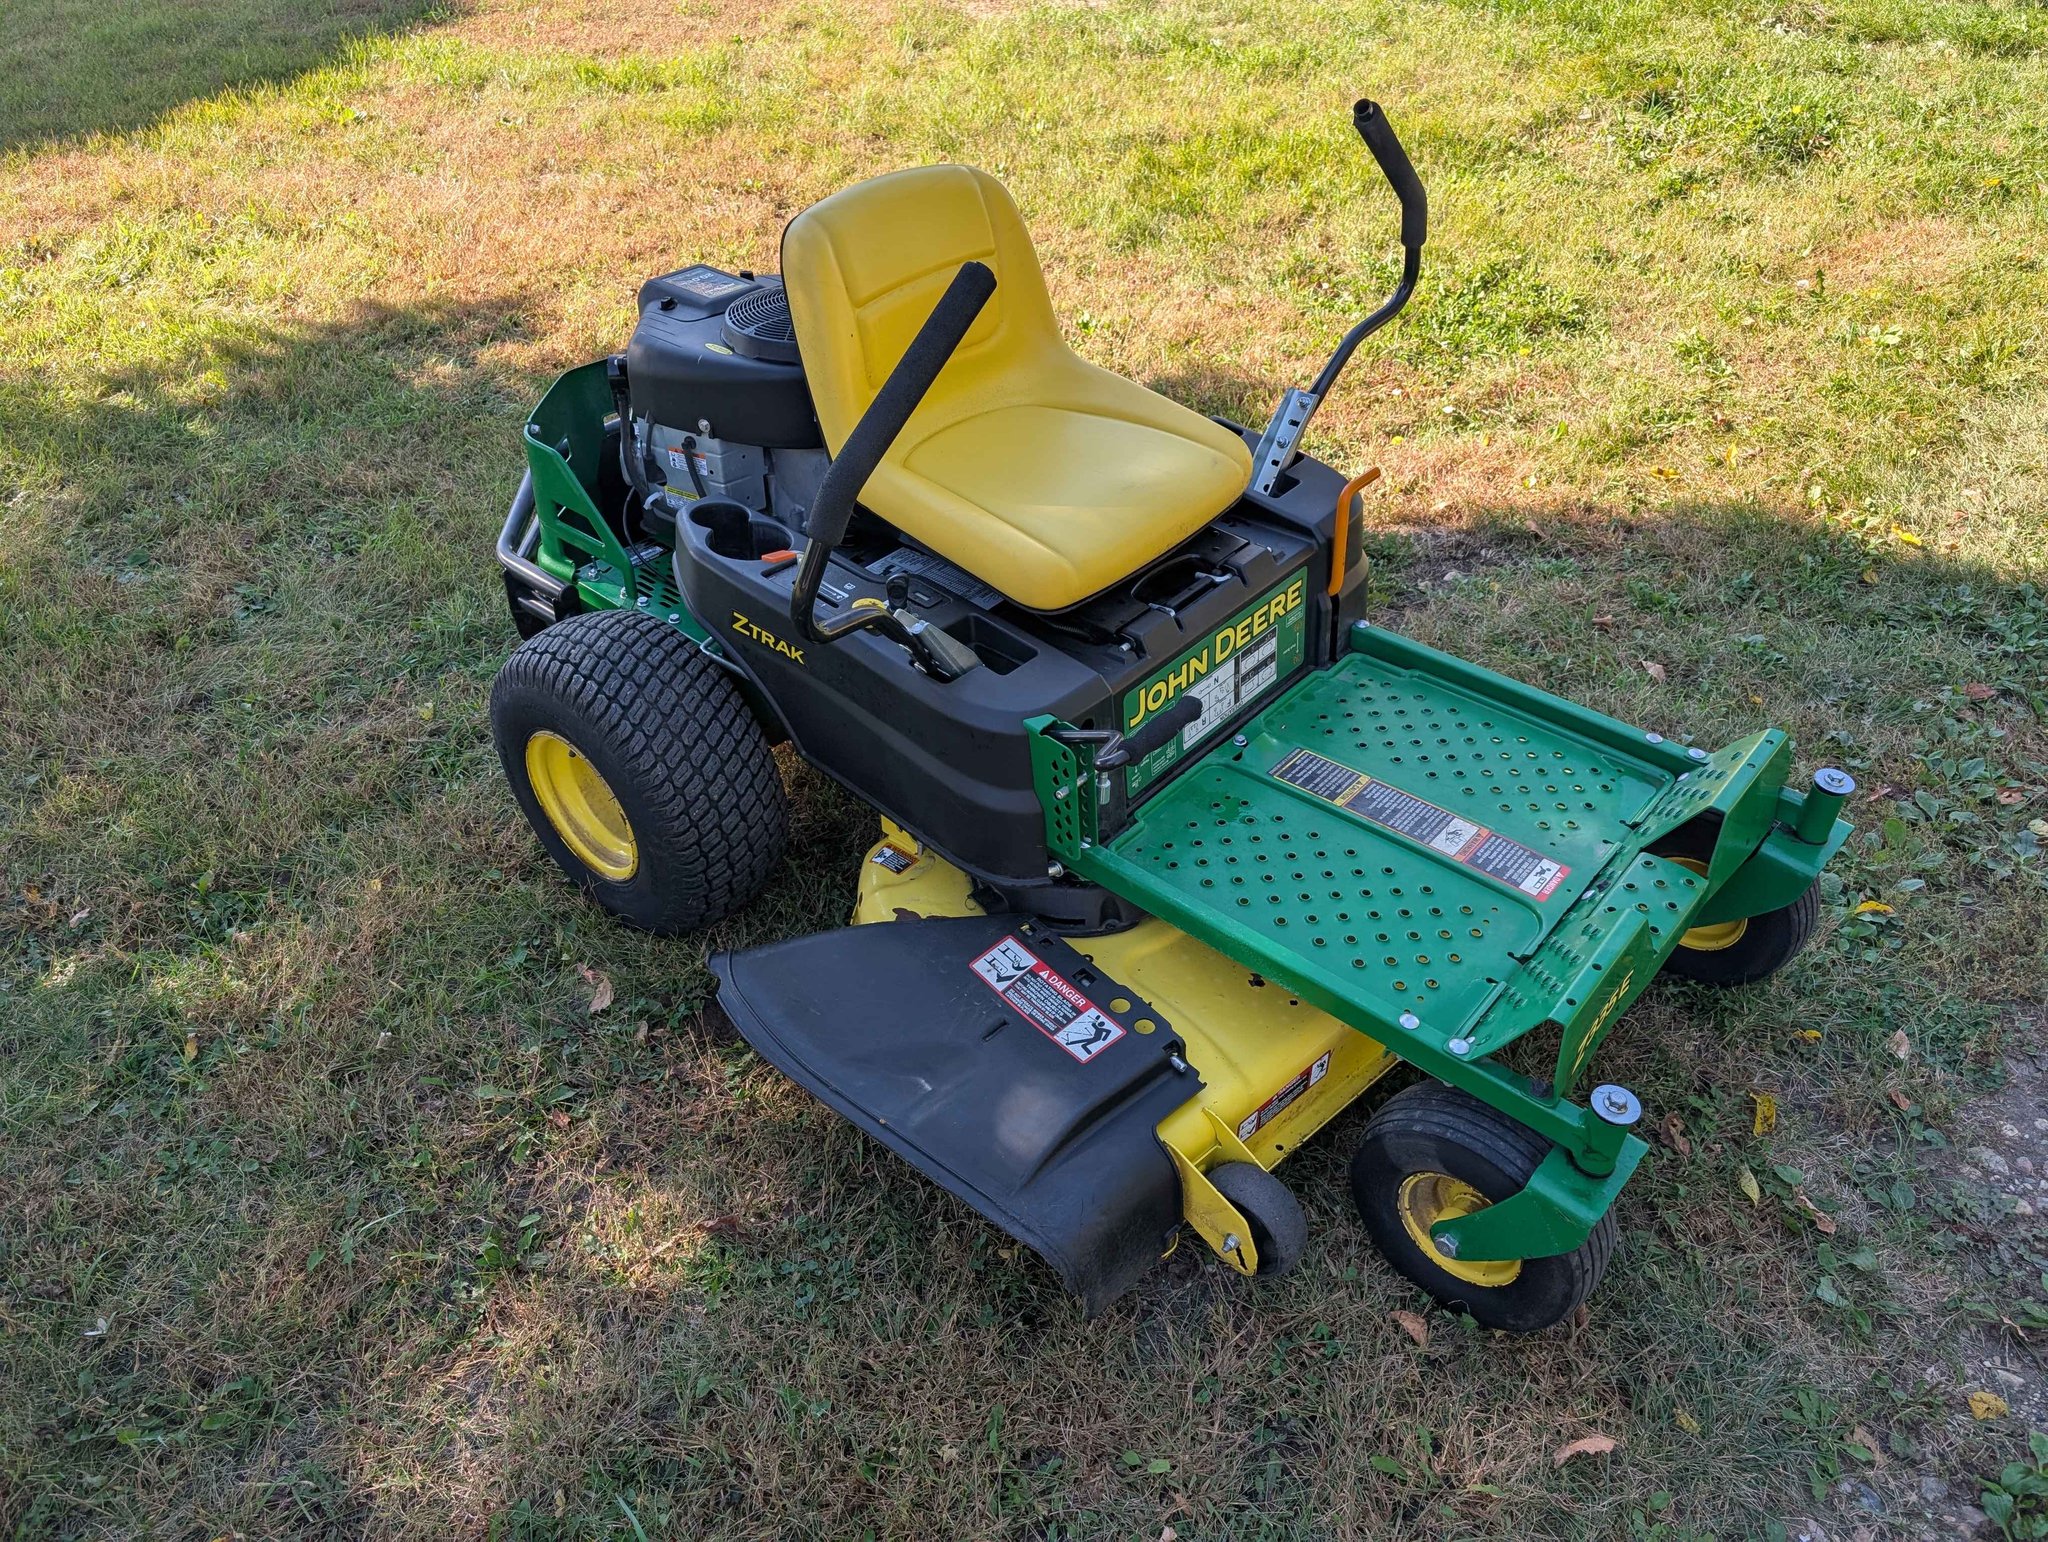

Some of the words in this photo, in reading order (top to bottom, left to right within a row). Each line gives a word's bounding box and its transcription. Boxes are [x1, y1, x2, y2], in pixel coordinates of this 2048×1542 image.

[732, 610, 805, 665] ZTRAK
[1129, 647, 1209, 727] JOHN
[1215, 579, 1302, 665] DEERE
[1025, 983, 1045, 1000] THROWN
[1043, 999, 1064, 1016] OBJECTS
[1048, 975, 1087, 1007] DANGER
